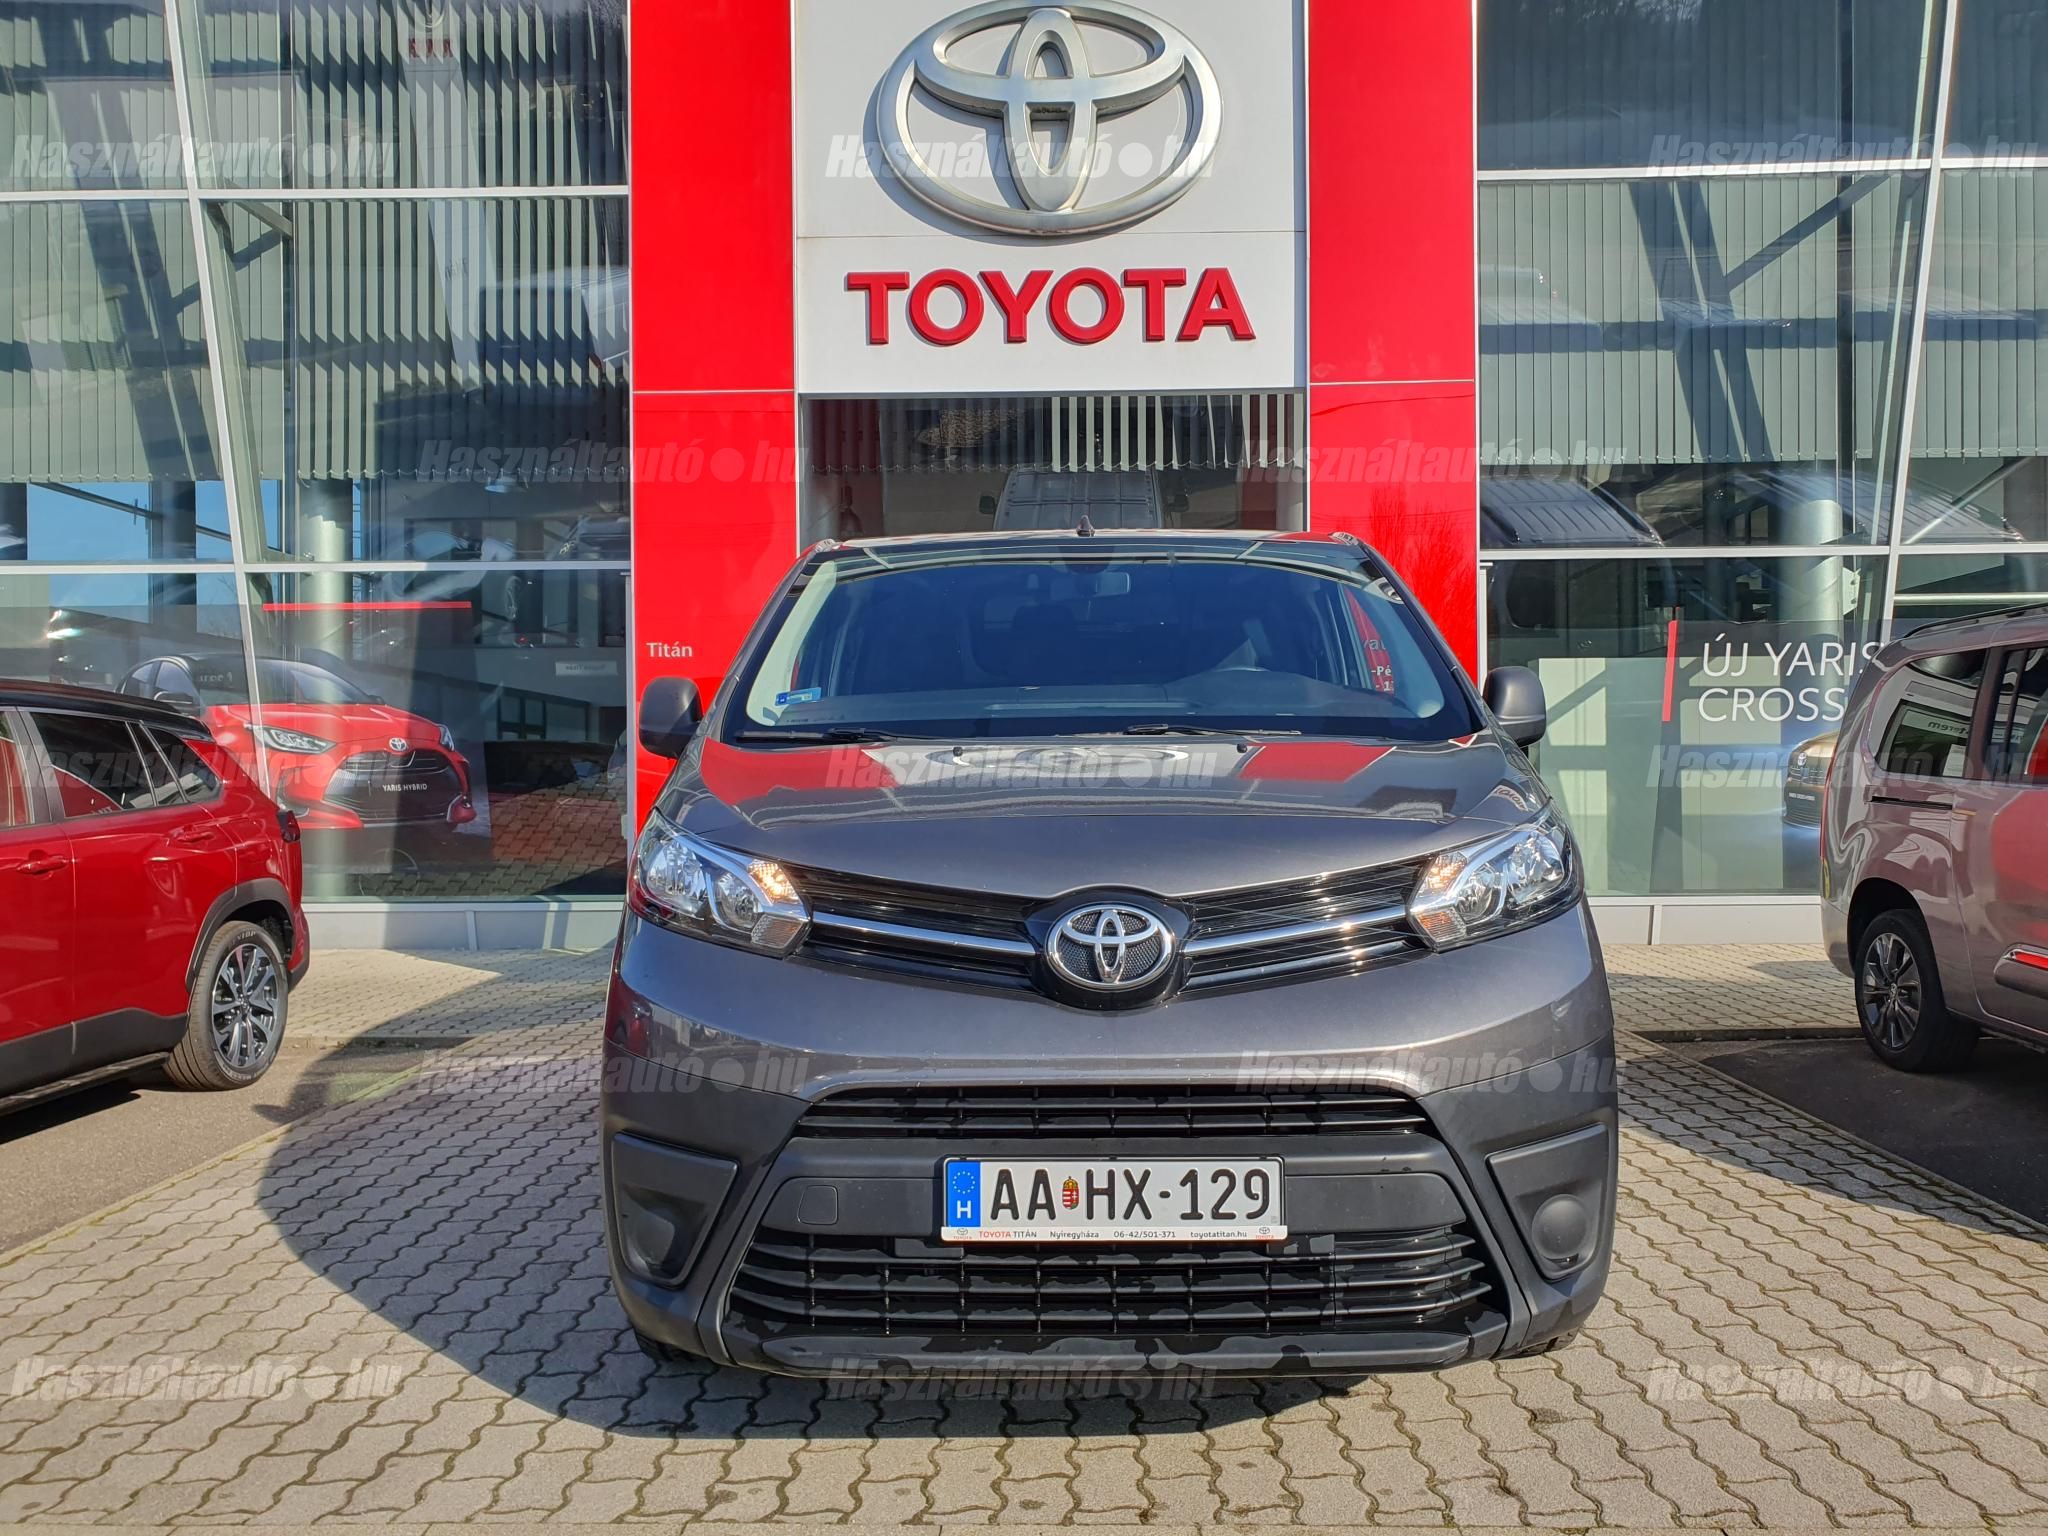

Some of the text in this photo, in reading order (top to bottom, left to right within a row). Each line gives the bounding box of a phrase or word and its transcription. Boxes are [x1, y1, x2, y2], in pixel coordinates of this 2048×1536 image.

[845, 267, 1256, 345] TOYOTA
[646, 641, 693, 658] Titán
[1703, 633, 1749, 677] ÚJ
[1698, 687, 1845, 722] CROSS
[382, 783, 428, 792] YARIS HYBRID
[990, 1168, 1270, 1220] AA HX-129
[956, 1201, 972, 1219] H
[1013, 1228, 1037, 1238] TITÁN
[1050, 1230, 1099, 1240] Nyíregyháza
[1114, 1231, 1176, 1239] 06-42/501-371
[1190, 1230, 1247, 1239] toyotatitan.hu
